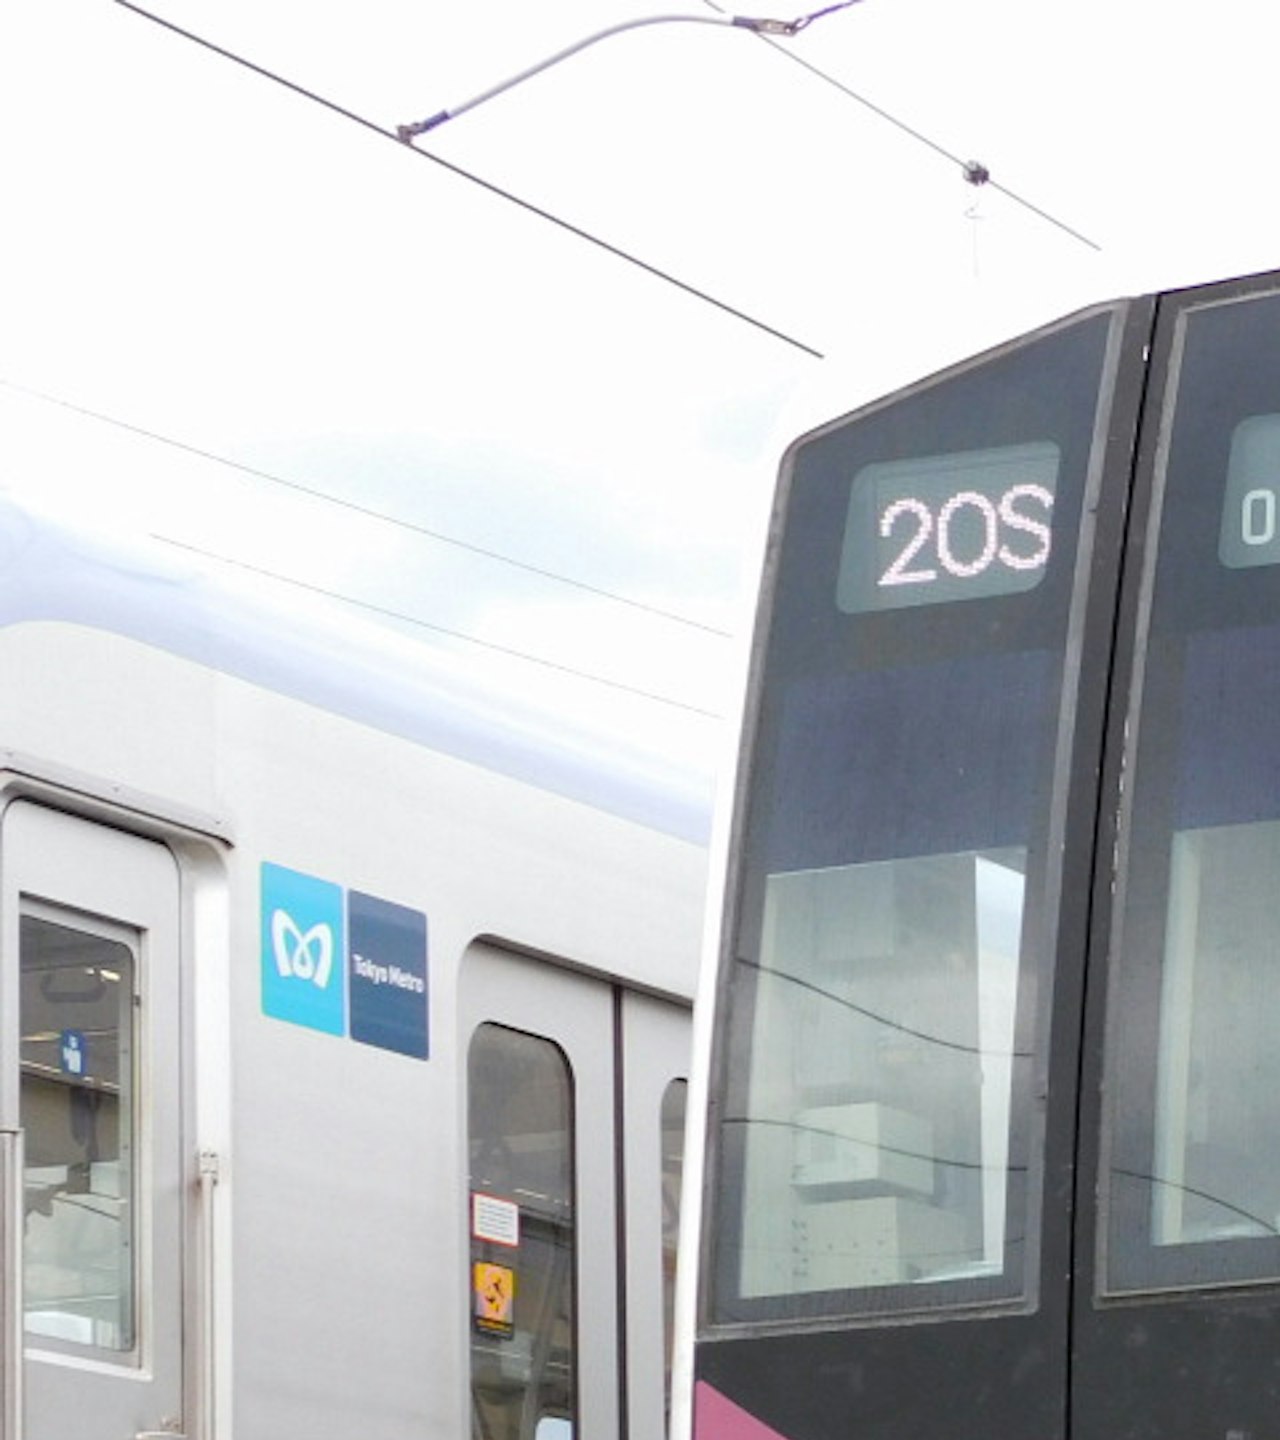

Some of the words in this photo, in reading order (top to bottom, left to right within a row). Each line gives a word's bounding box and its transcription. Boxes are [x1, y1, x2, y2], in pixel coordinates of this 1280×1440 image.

[876, 483, 1055, 586] 20S
[352, 953, 388, 985] Tokyo
[388, 964, 425, 993] Metro
